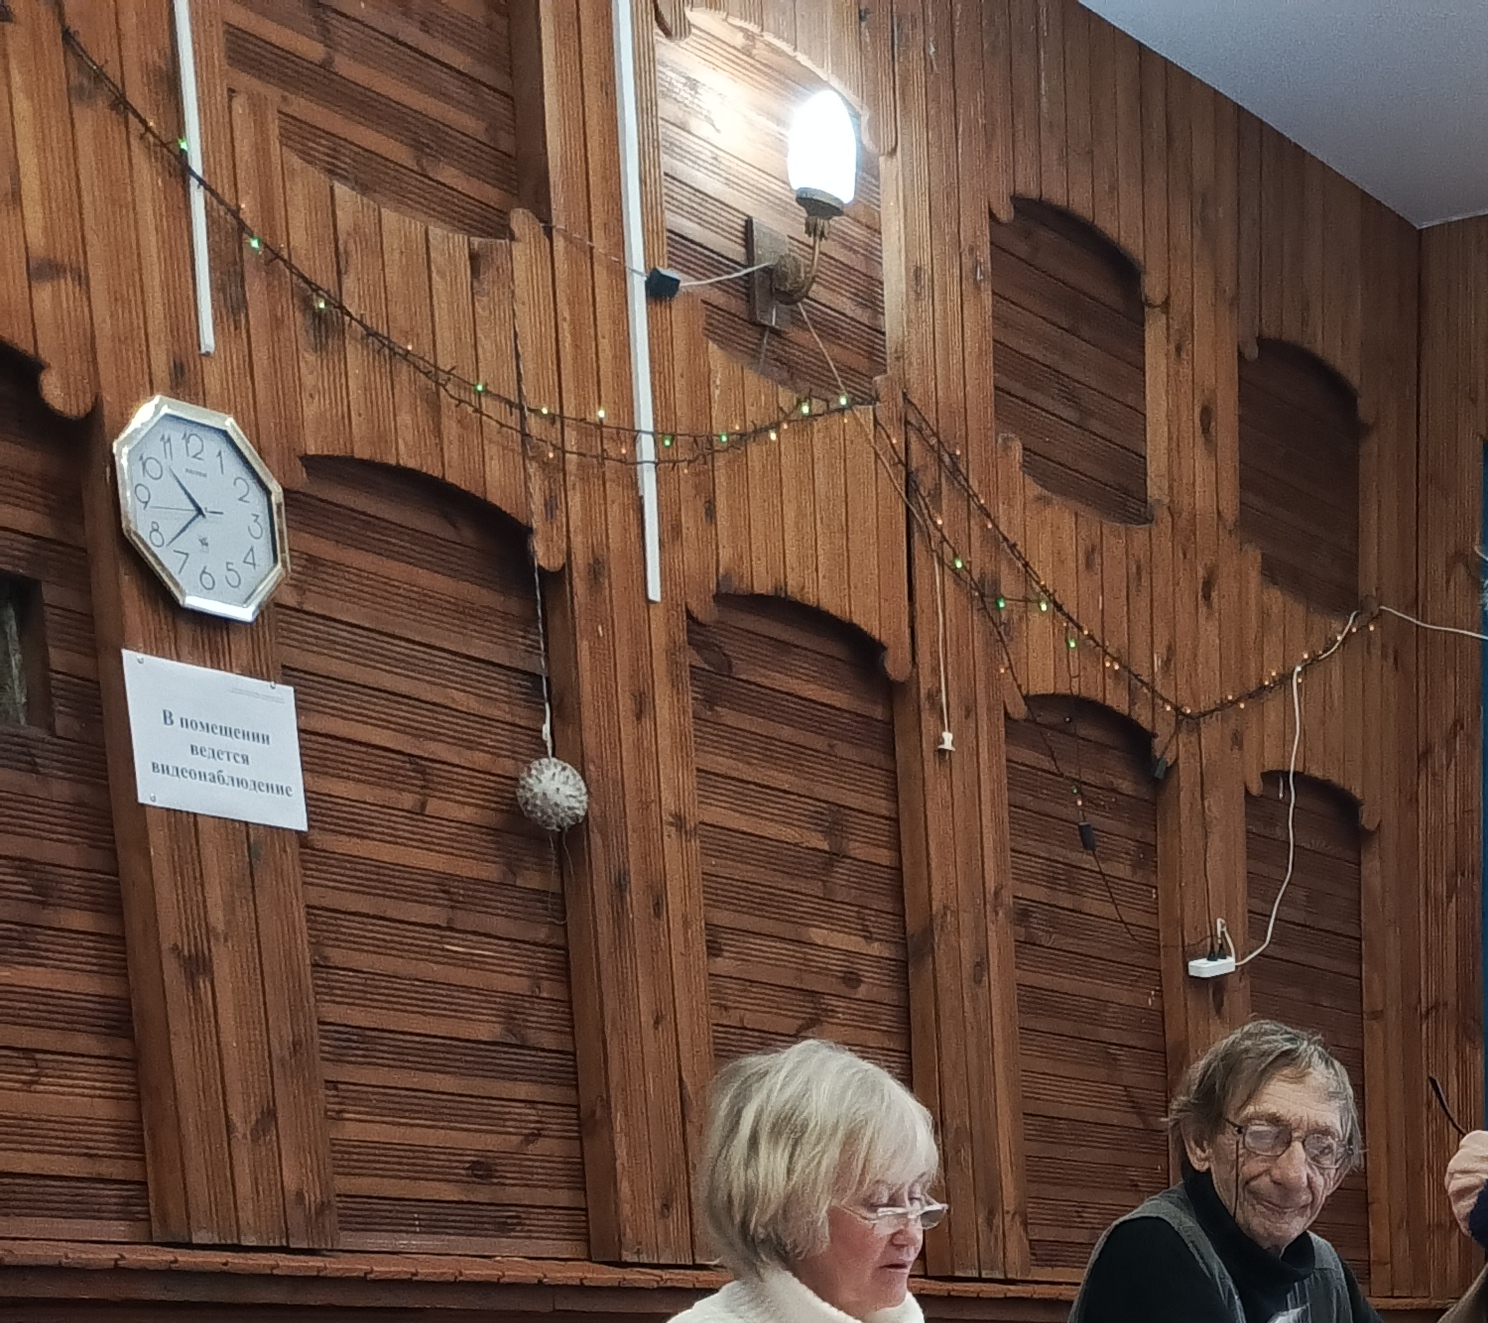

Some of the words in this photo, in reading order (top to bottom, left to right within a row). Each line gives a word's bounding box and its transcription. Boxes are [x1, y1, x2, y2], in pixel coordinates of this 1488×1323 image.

[160, 433, 173, 461] 11
[182, 430, 205, 461] 12
[139, 453, 163, 480] 10
[216, 450, 224, 475] 1
[134, 483, 151, 510] 9
[233, 477, 250, 503] 2
[149, 521, 164, 548] 8
[248, 513, 263, 540] 3
[173, 550, 189, 574] 7
[243, 545, 258, 570] 4
[200, 566, 215, 590] 6
[225, 562, 241, 588] 5
[162, 709, 174, 726] В
[180, 717, 270, 746] помещении
[190, 744, 250, 766] ведется
[151, 761, 293, 797] видеонаблюдение
